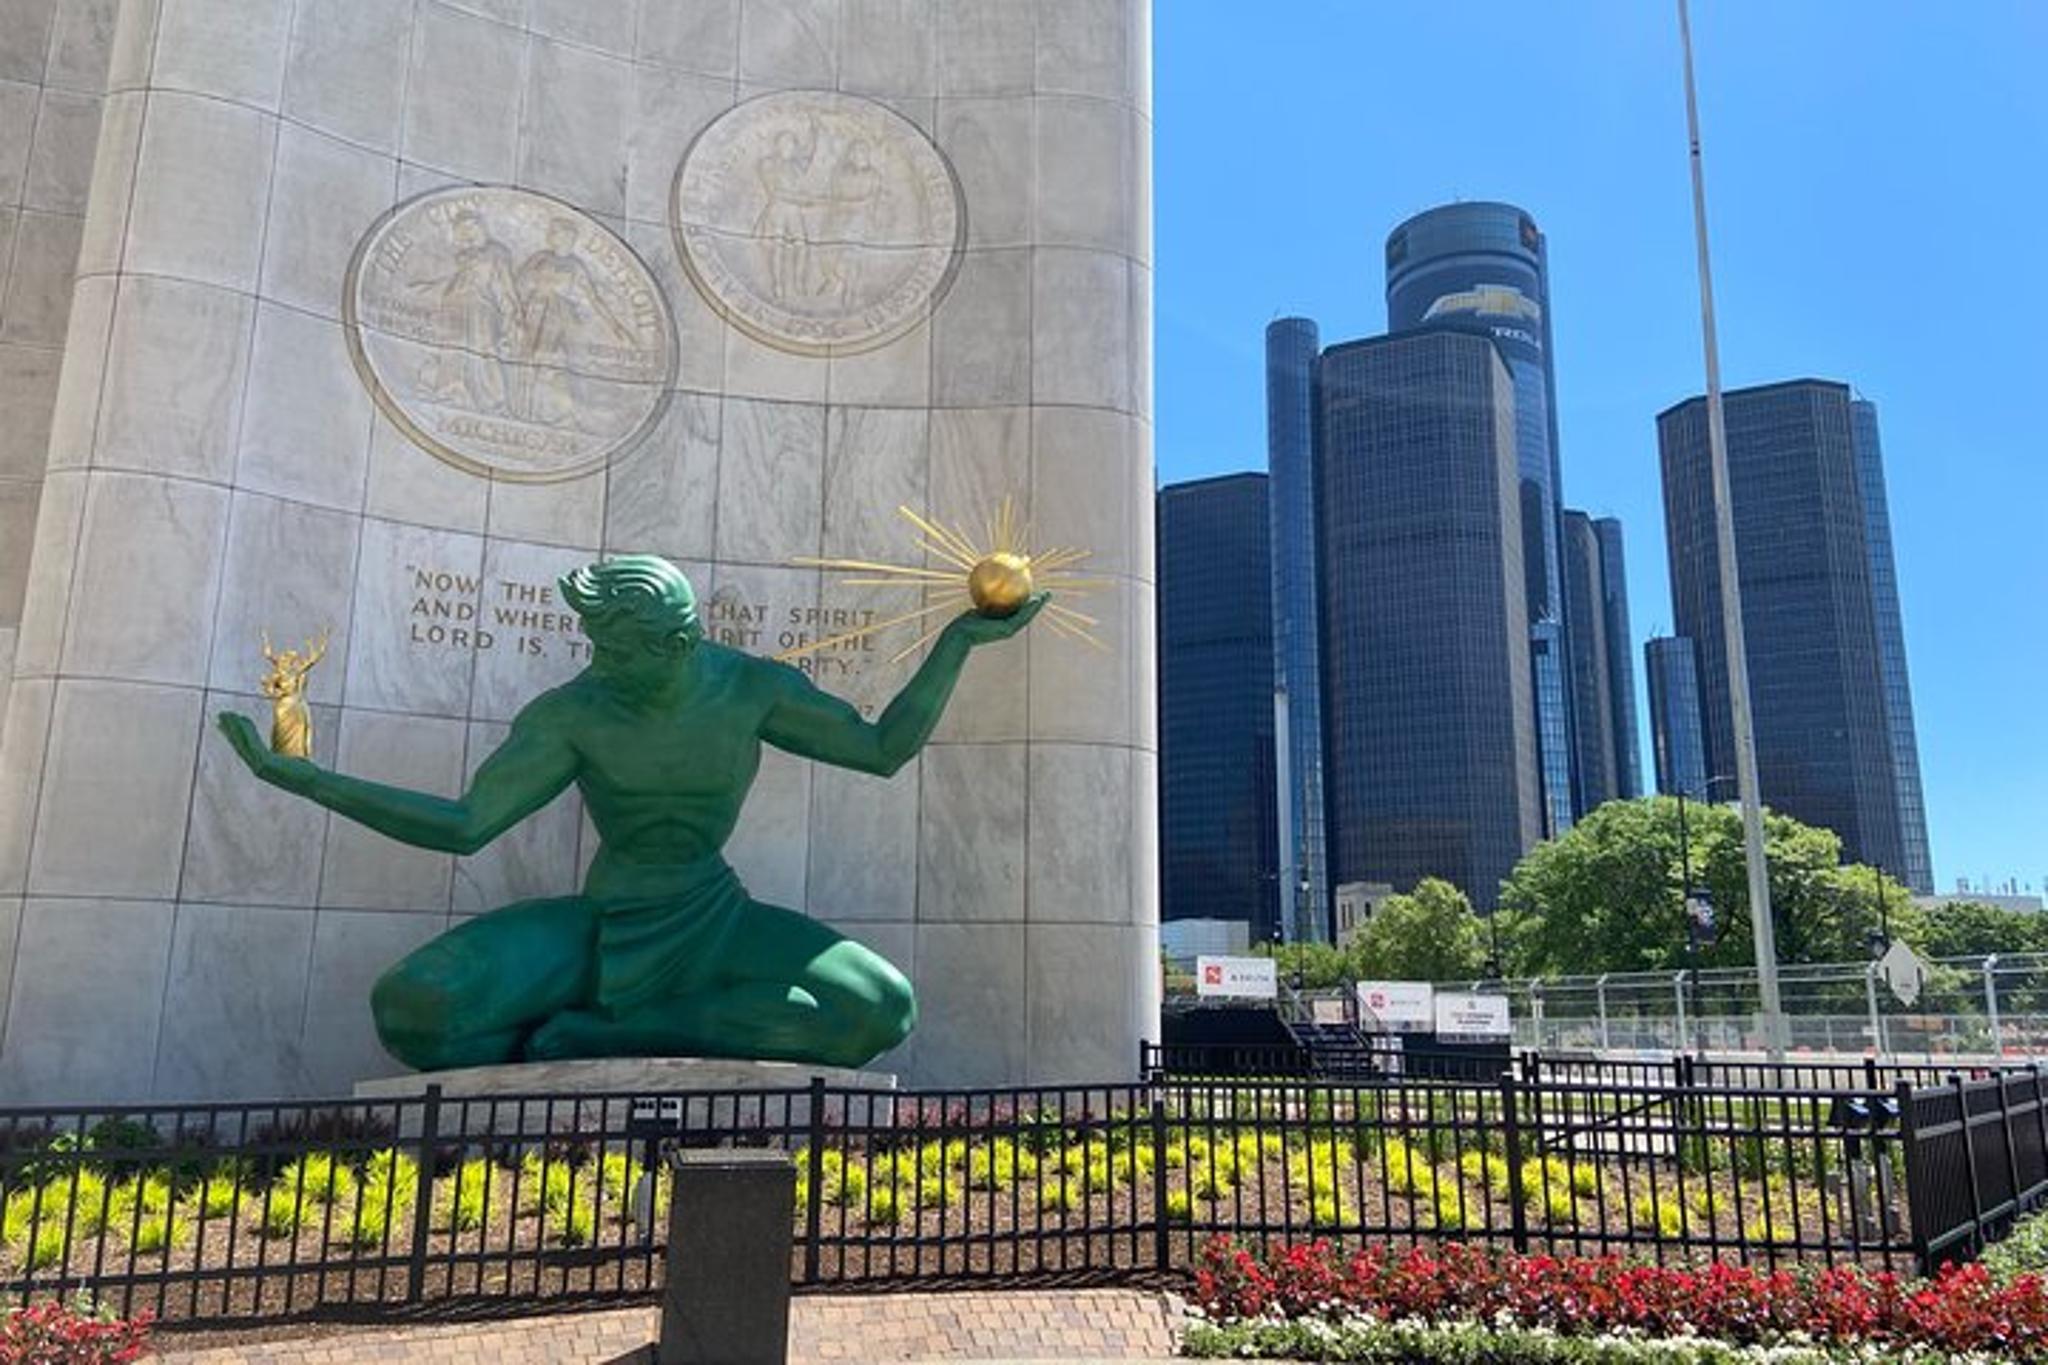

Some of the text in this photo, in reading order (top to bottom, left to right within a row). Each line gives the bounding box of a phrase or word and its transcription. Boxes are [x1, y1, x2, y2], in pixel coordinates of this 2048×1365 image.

[411, 597, 474, 621] AND
[779, 630, 811, 650] OF
[500, 581, 553, 604] THE
[790, 607, 875, 628] SPIRIT
[411, 623, 494, 649] LORD
